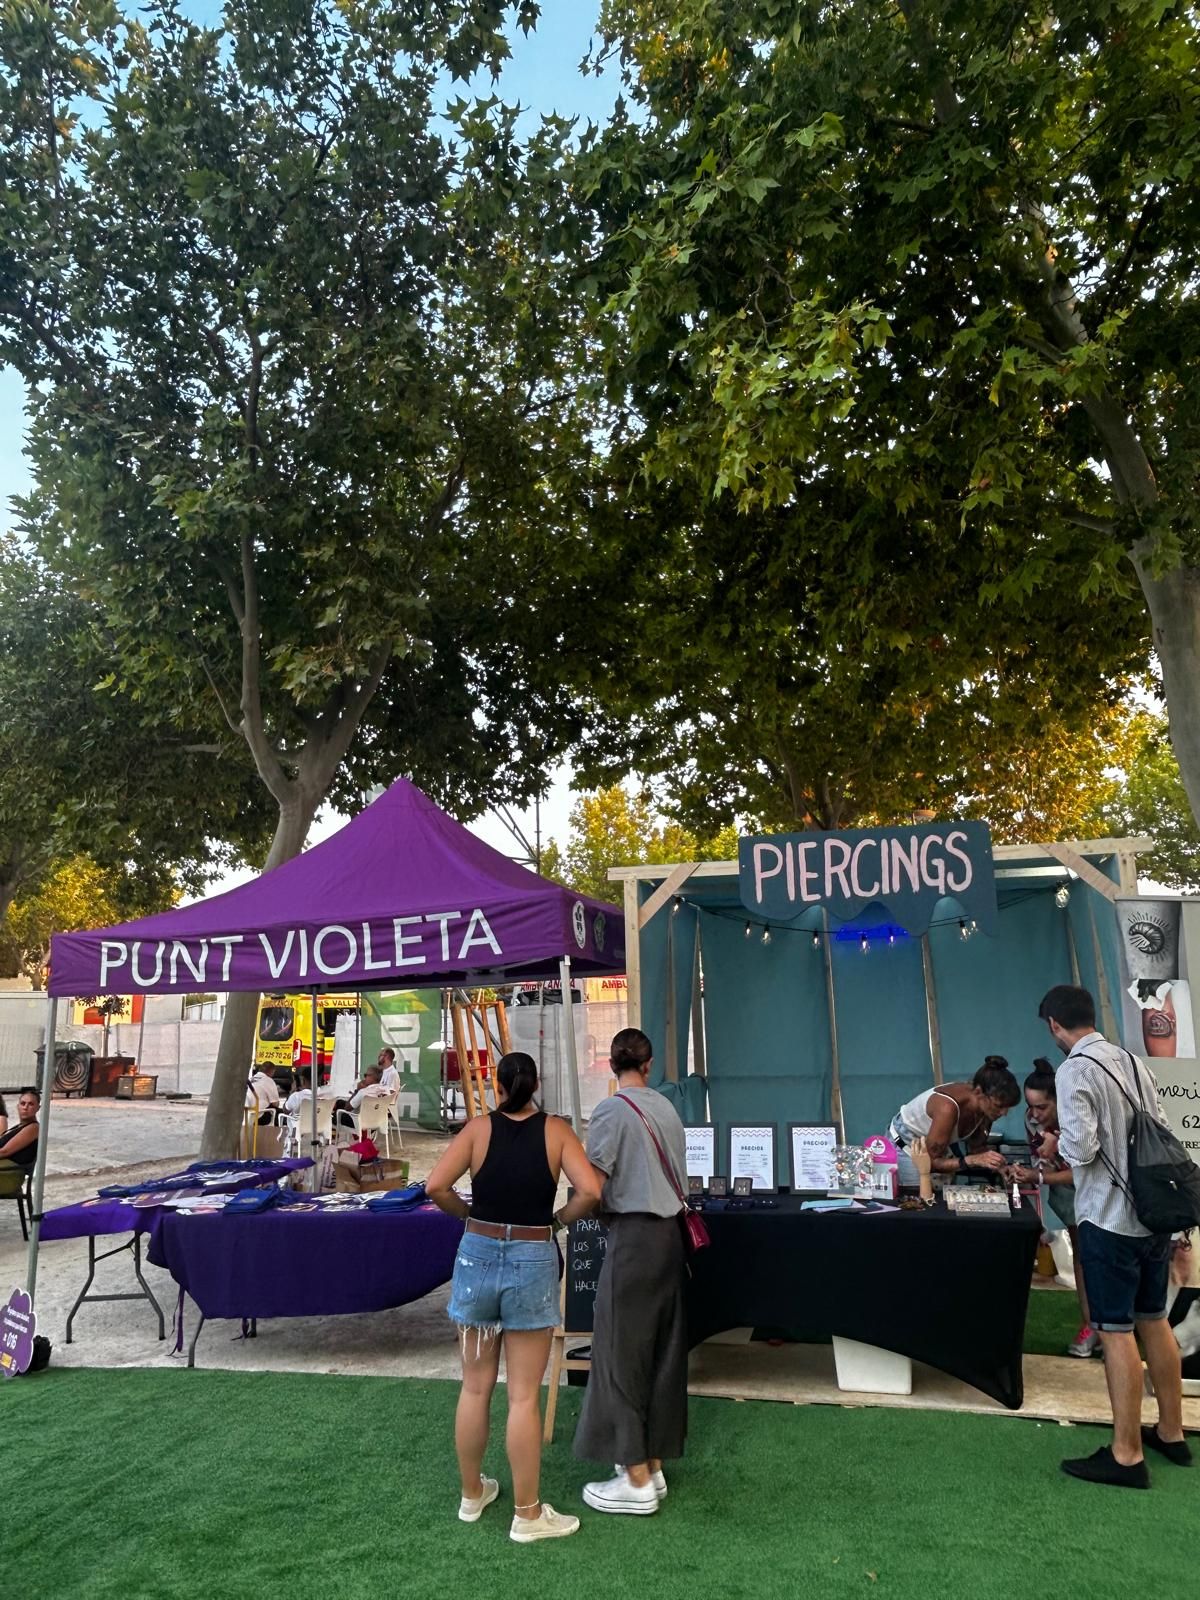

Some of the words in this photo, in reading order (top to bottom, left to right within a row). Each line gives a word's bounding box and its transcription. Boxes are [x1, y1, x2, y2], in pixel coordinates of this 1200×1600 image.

[753, 831, 973, 904] PIERCINGS
[100, 935, 244, 987] PUNT
[258, 908, 503, 979] VIOLETA
[576, 1219, 601, 1232] PARA
[573, 1240, 590, 1252] LOS
[572, 1258, 593, 1271] QUE
